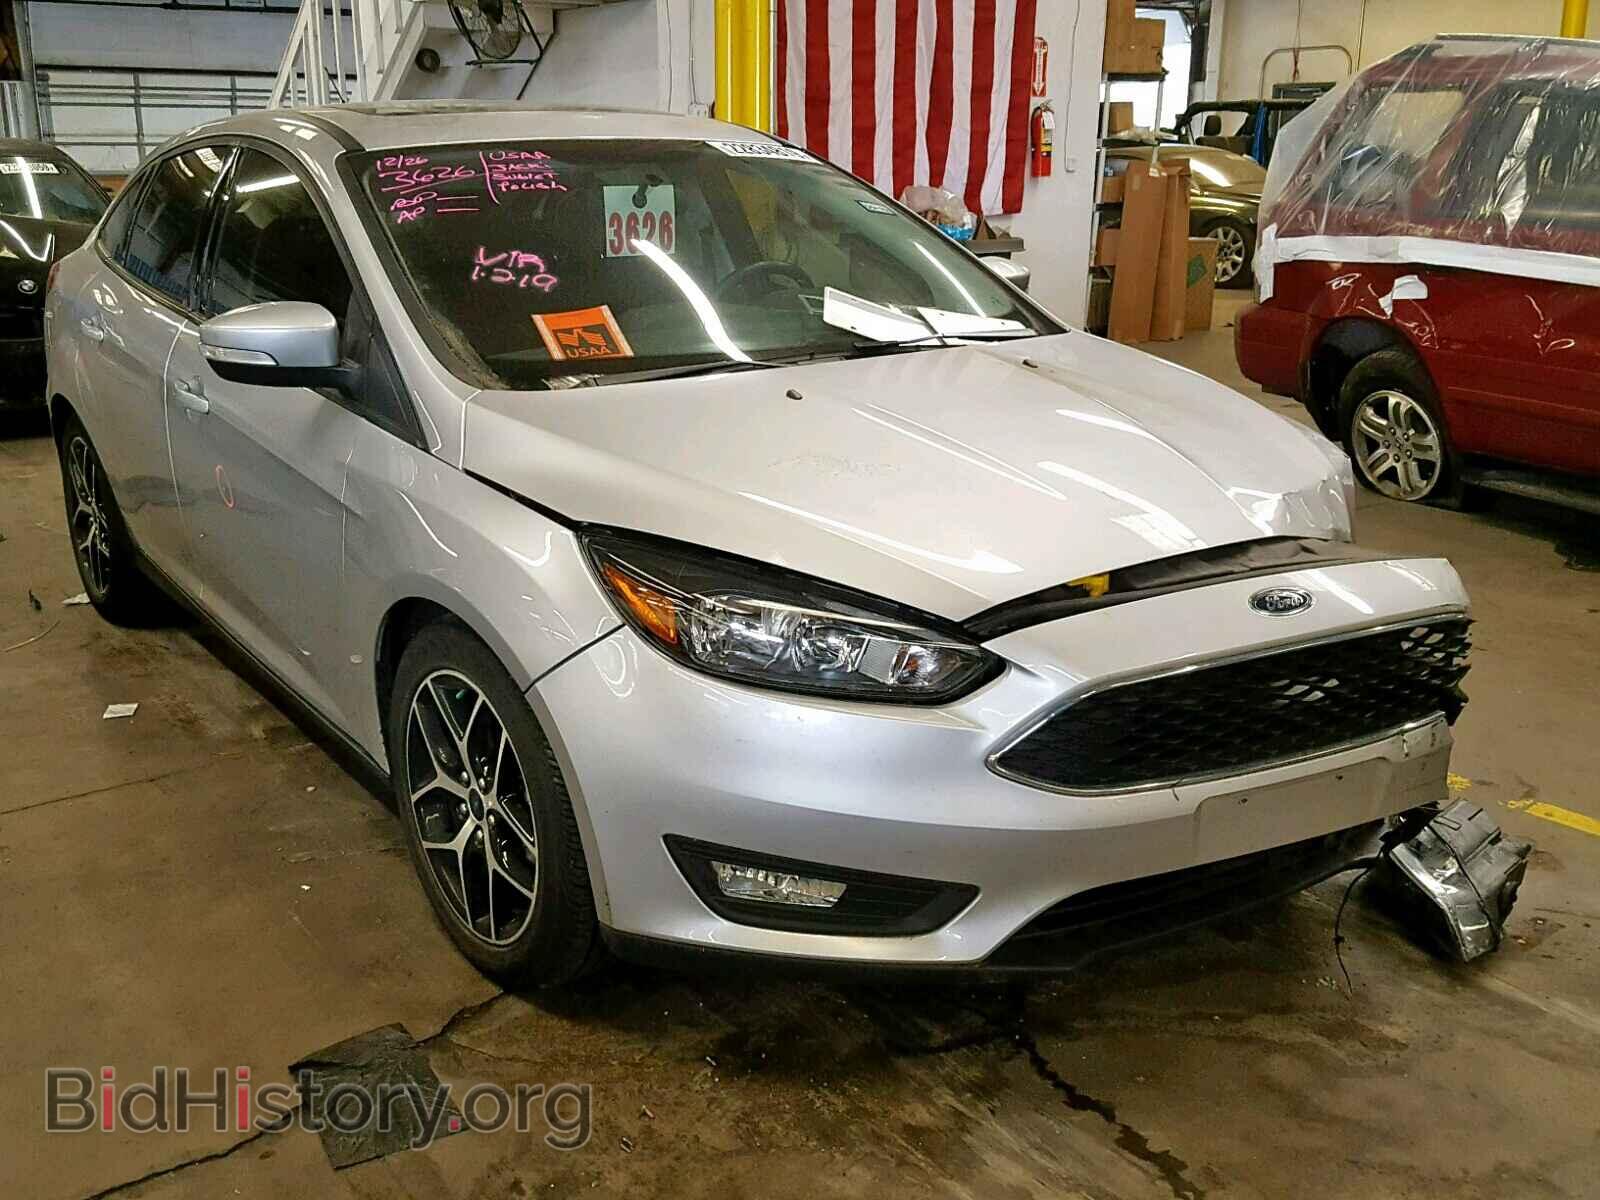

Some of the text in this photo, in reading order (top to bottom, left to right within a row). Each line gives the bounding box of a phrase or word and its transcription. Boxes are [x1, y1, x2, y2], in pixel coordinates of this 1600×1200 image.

[377, 154, 429, 171] 12/26
[379, 165, 476, 192] 3626
[608, 211, 674, 255] 3626
[565, 346, 611, 358] USAA
